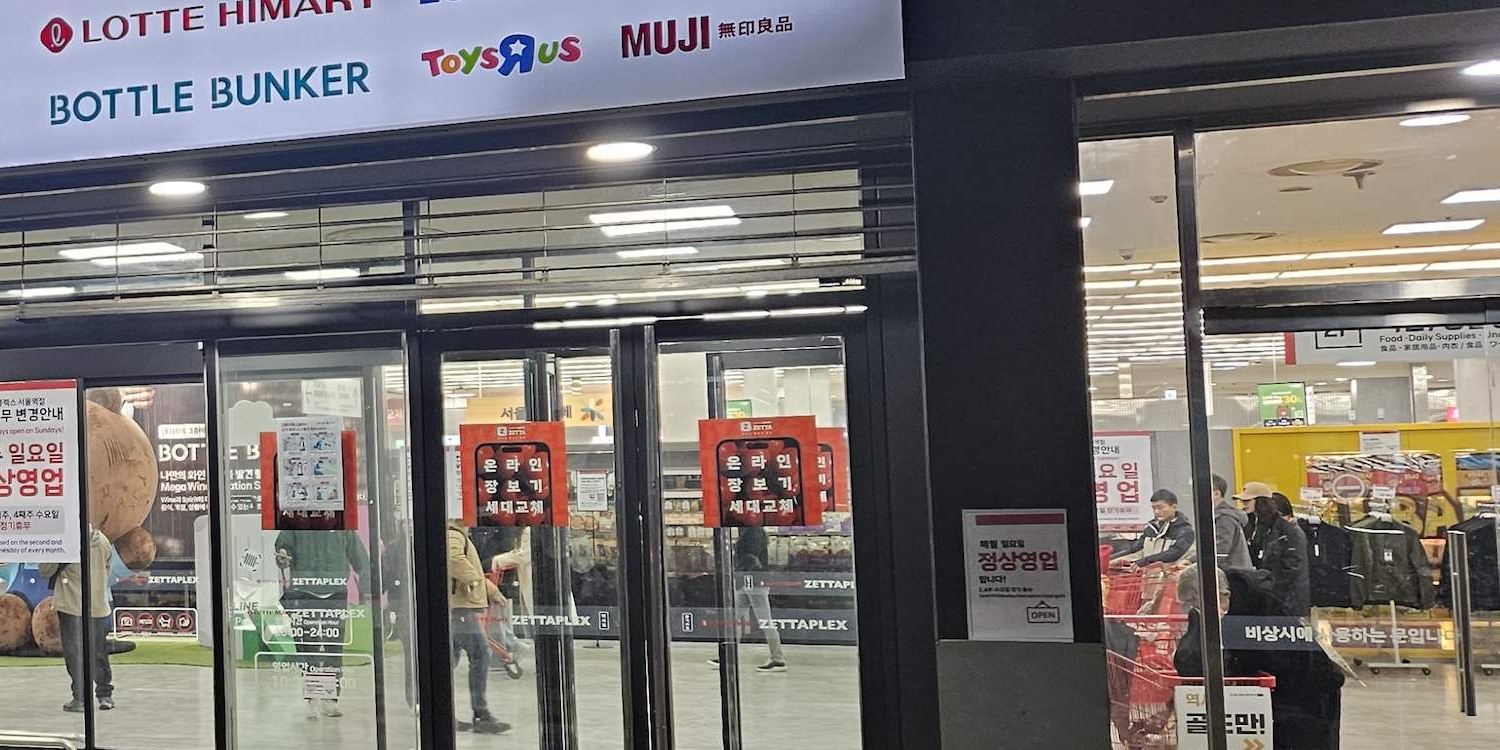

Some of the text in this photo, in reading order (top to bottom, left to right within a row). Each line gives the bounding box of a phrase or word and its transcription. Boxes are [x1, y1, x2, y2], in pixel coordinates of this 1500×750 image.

[83, 6, 204, 43] LOTTE
[621, 15, 793, 58] MUJI 無印良品
[50, 61, 370, 125] BOTTLE BUNKER
[1379, 335, 1403, 343] Food
[1435, 332, 1477, 342] Supplies
[18, 397, 46, 406] 서울역점
[16, 407, 64, 422] 변경안내
[9, 428, 25, 436] open
[35, 426, 64, 434] Sundays!
[8, 442, 64, 464] 일요일
[1093, 445, 1120, 455] 경안내
[160, 482, 187, 493] Mega
[187, 481, 208, 491] Win
[485, 501, 544, 514] 세대교체
[729, 499, 795, 514] 세대교체
[36, 511, 59, 519] 수요일
[0, 521, 32, 531] 정기휴무
[28, 548, 45, 556] every
[978, 551, 1059, 571] 정상영업
[147, 576, 199, 584] ZETTAPLEX
[292, 578, 347, 586] ZETTAPLEX
[295, 609, 366, 619] ZETTAPLEX
[1030, 611, 1056, 619] OPEN
[510, 615, 591, 626] ZETTAPLEX
[758, 618, 848, 631] ZETTAPLEX
[1245, 625, 1313, 643] 비상시에
[1318, 627, 1387, 643] 용하는
[1186, 713, 1265, 735] 골만!
